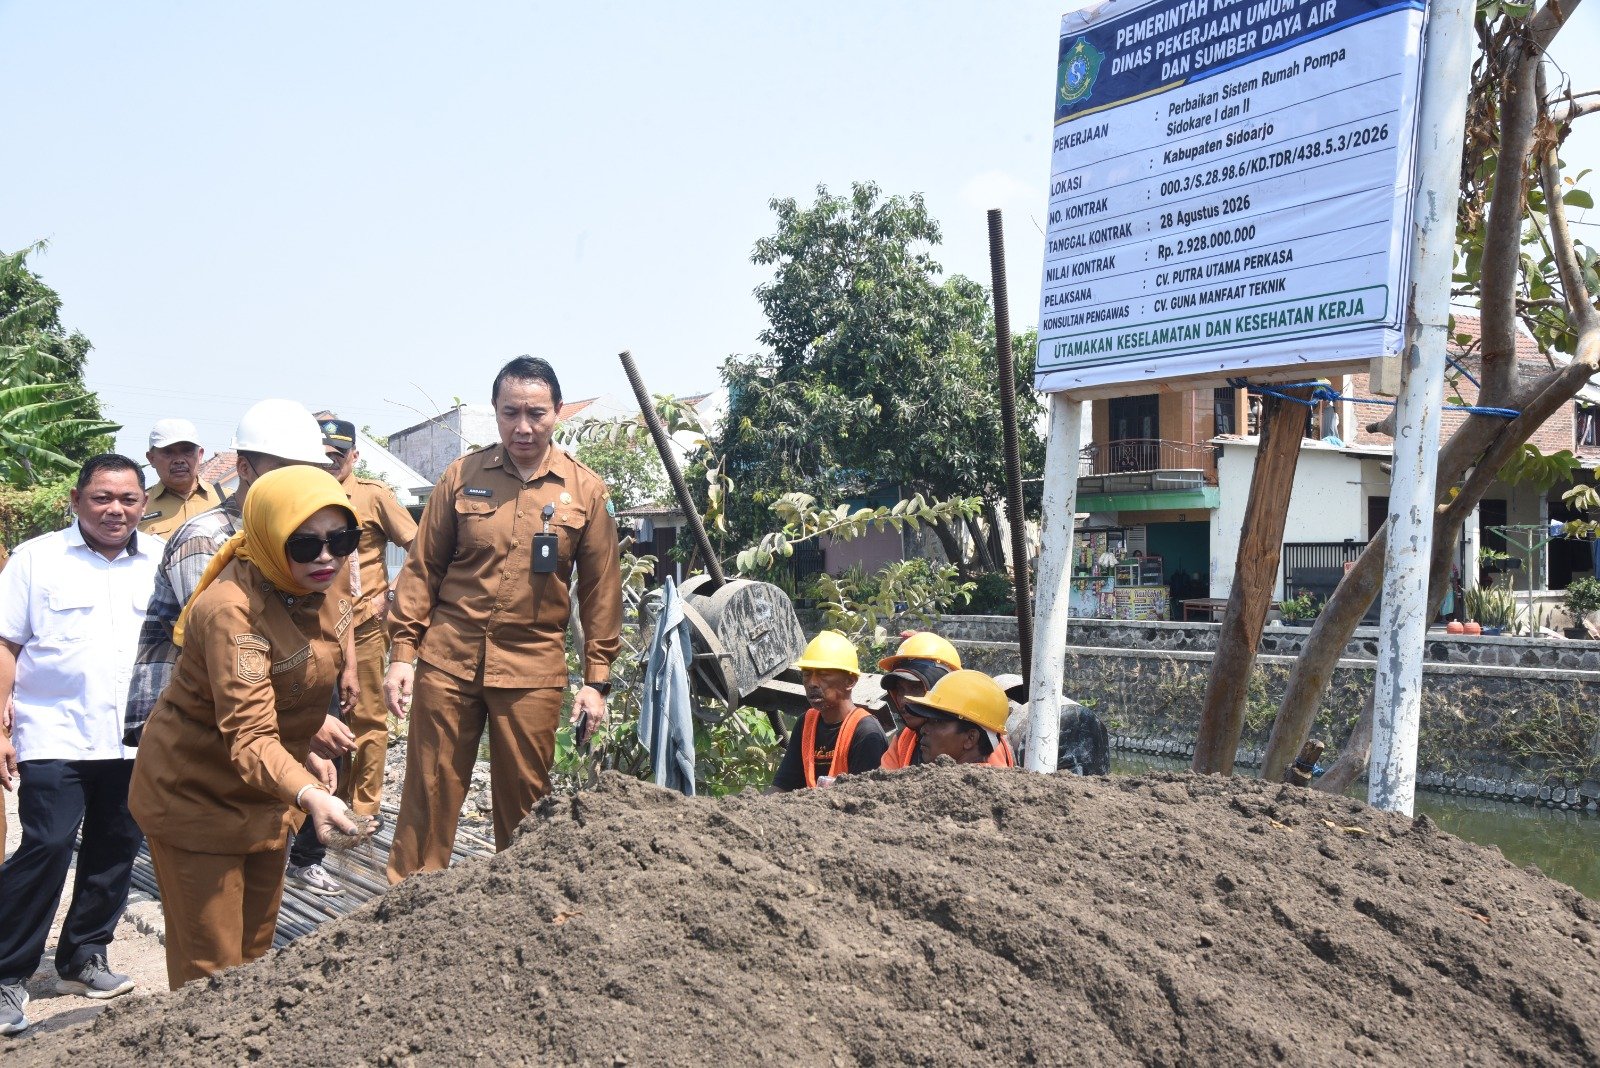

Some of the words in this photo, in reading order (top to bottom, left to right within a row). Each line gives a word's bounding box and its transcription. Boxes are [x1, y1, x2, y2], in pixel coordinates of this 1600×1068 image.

[1115, 0, 1209, 50] PEMERINTAH
[1161, 54, 1190, 80] DAN
[1194, 30, 1257, 69] SUMBER
[1261, 13, 1302, 45] DAYA
[1307, 0, 1337, 28] AIR
[1111, 46, 1152, 76] DINAS
[1155, 11, 1241, 60] PEKERJAAN
[1168, 91, 1219, 117] Perbaikan
[1221, 78, 1258, 100] Sistem
[1261, 60, 1300, 88] Rumah
[1303, 48, 1346, 72] Pompa
[1166, 114, 1212, 137] Sidokare
[1214, 108, 1218, 122] I
[1220, 104, 1240, 121] dan
[1242, 97, 1250, 114] II
[1053, 123, 1109, 154] PEKERJAAN
[1163, 139, 1223, 165] Kabupaten
[1225, 122, 1274, 148] Sidoarjo
[1051, 175, 1082, 197] LOKASI
[1048, 209, 1063, 226] NO.
[1065, 197, 1108, 221] KONTRAK
[1160, 213, 1174, 230] 28
[1177, 205, 1220, 228] Agustus
[1222, 194, 1251, 216] 2026
[1048, 233, 1087, 254] TANGGAL
[1089, 222, 1133, 245] KONTRAK
[1158, 244, 1174, 261] Rp.
[1177, 224, 1256, 256] 2.928.000.000
[1046, 265, 1069, 282] NILAI
[1072, 255, 1116, 277] KONTRAK
[1155, 272, 1170, 288] CV.
[1172, 266, 1203, 285] PUTRA
[1206, 258, 1241, 278] UTAMA
[1243, 249, 1294, 271] PERKASA
[1044, 287, 1092, 308] PELAKSANA
[1153, 299, 1168, 313] CV.
[1170, 293, 1197, 310] GUNA
[1199, 284, 1247, 306] MANFAAT
[1249, 277, 1287, 297] TEKNIK
[1043, 312, 1085, 331] KONSULTAN
[1085, 305, 1130, 325] PENGAWAS
[1054, 336, 1113, 359] UTAMAKAN
[1116, 322, 1201, 350] KESELAMATAN
[1205, 318, 1232, 338] DAN
[1235, 305, 1314, 334] KESEHATAN
[1318, 297, 1365, 321] KERJA
